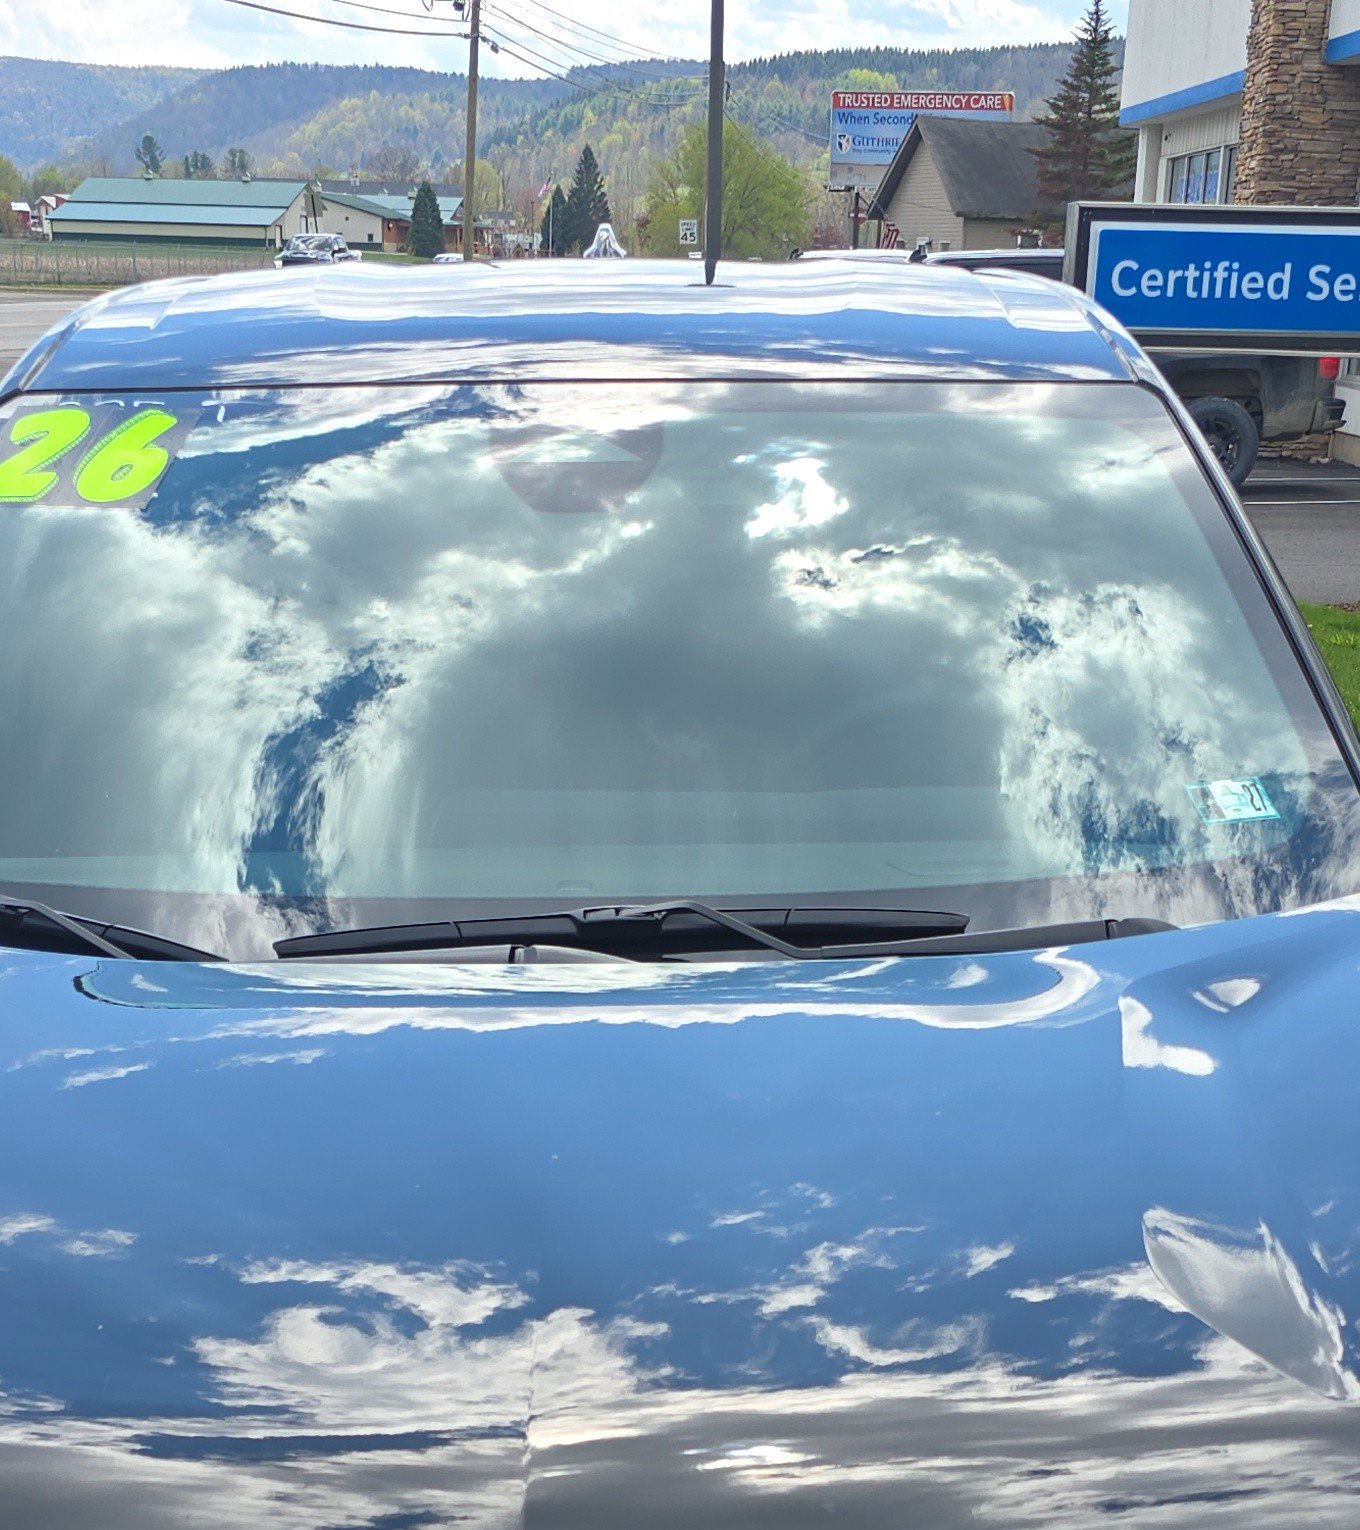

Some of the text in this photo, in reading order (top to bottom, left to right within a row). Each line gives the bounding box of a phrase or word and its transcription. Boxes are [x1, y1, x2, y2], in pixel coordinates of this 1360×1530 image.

[838, 94, 1002, 109] TRUSTED EMERGENCY CARE
[838, 112, 914, 125] When Second
[681, 232, 696, 242] 45
[1111, 260, 1292, 300] Certified
